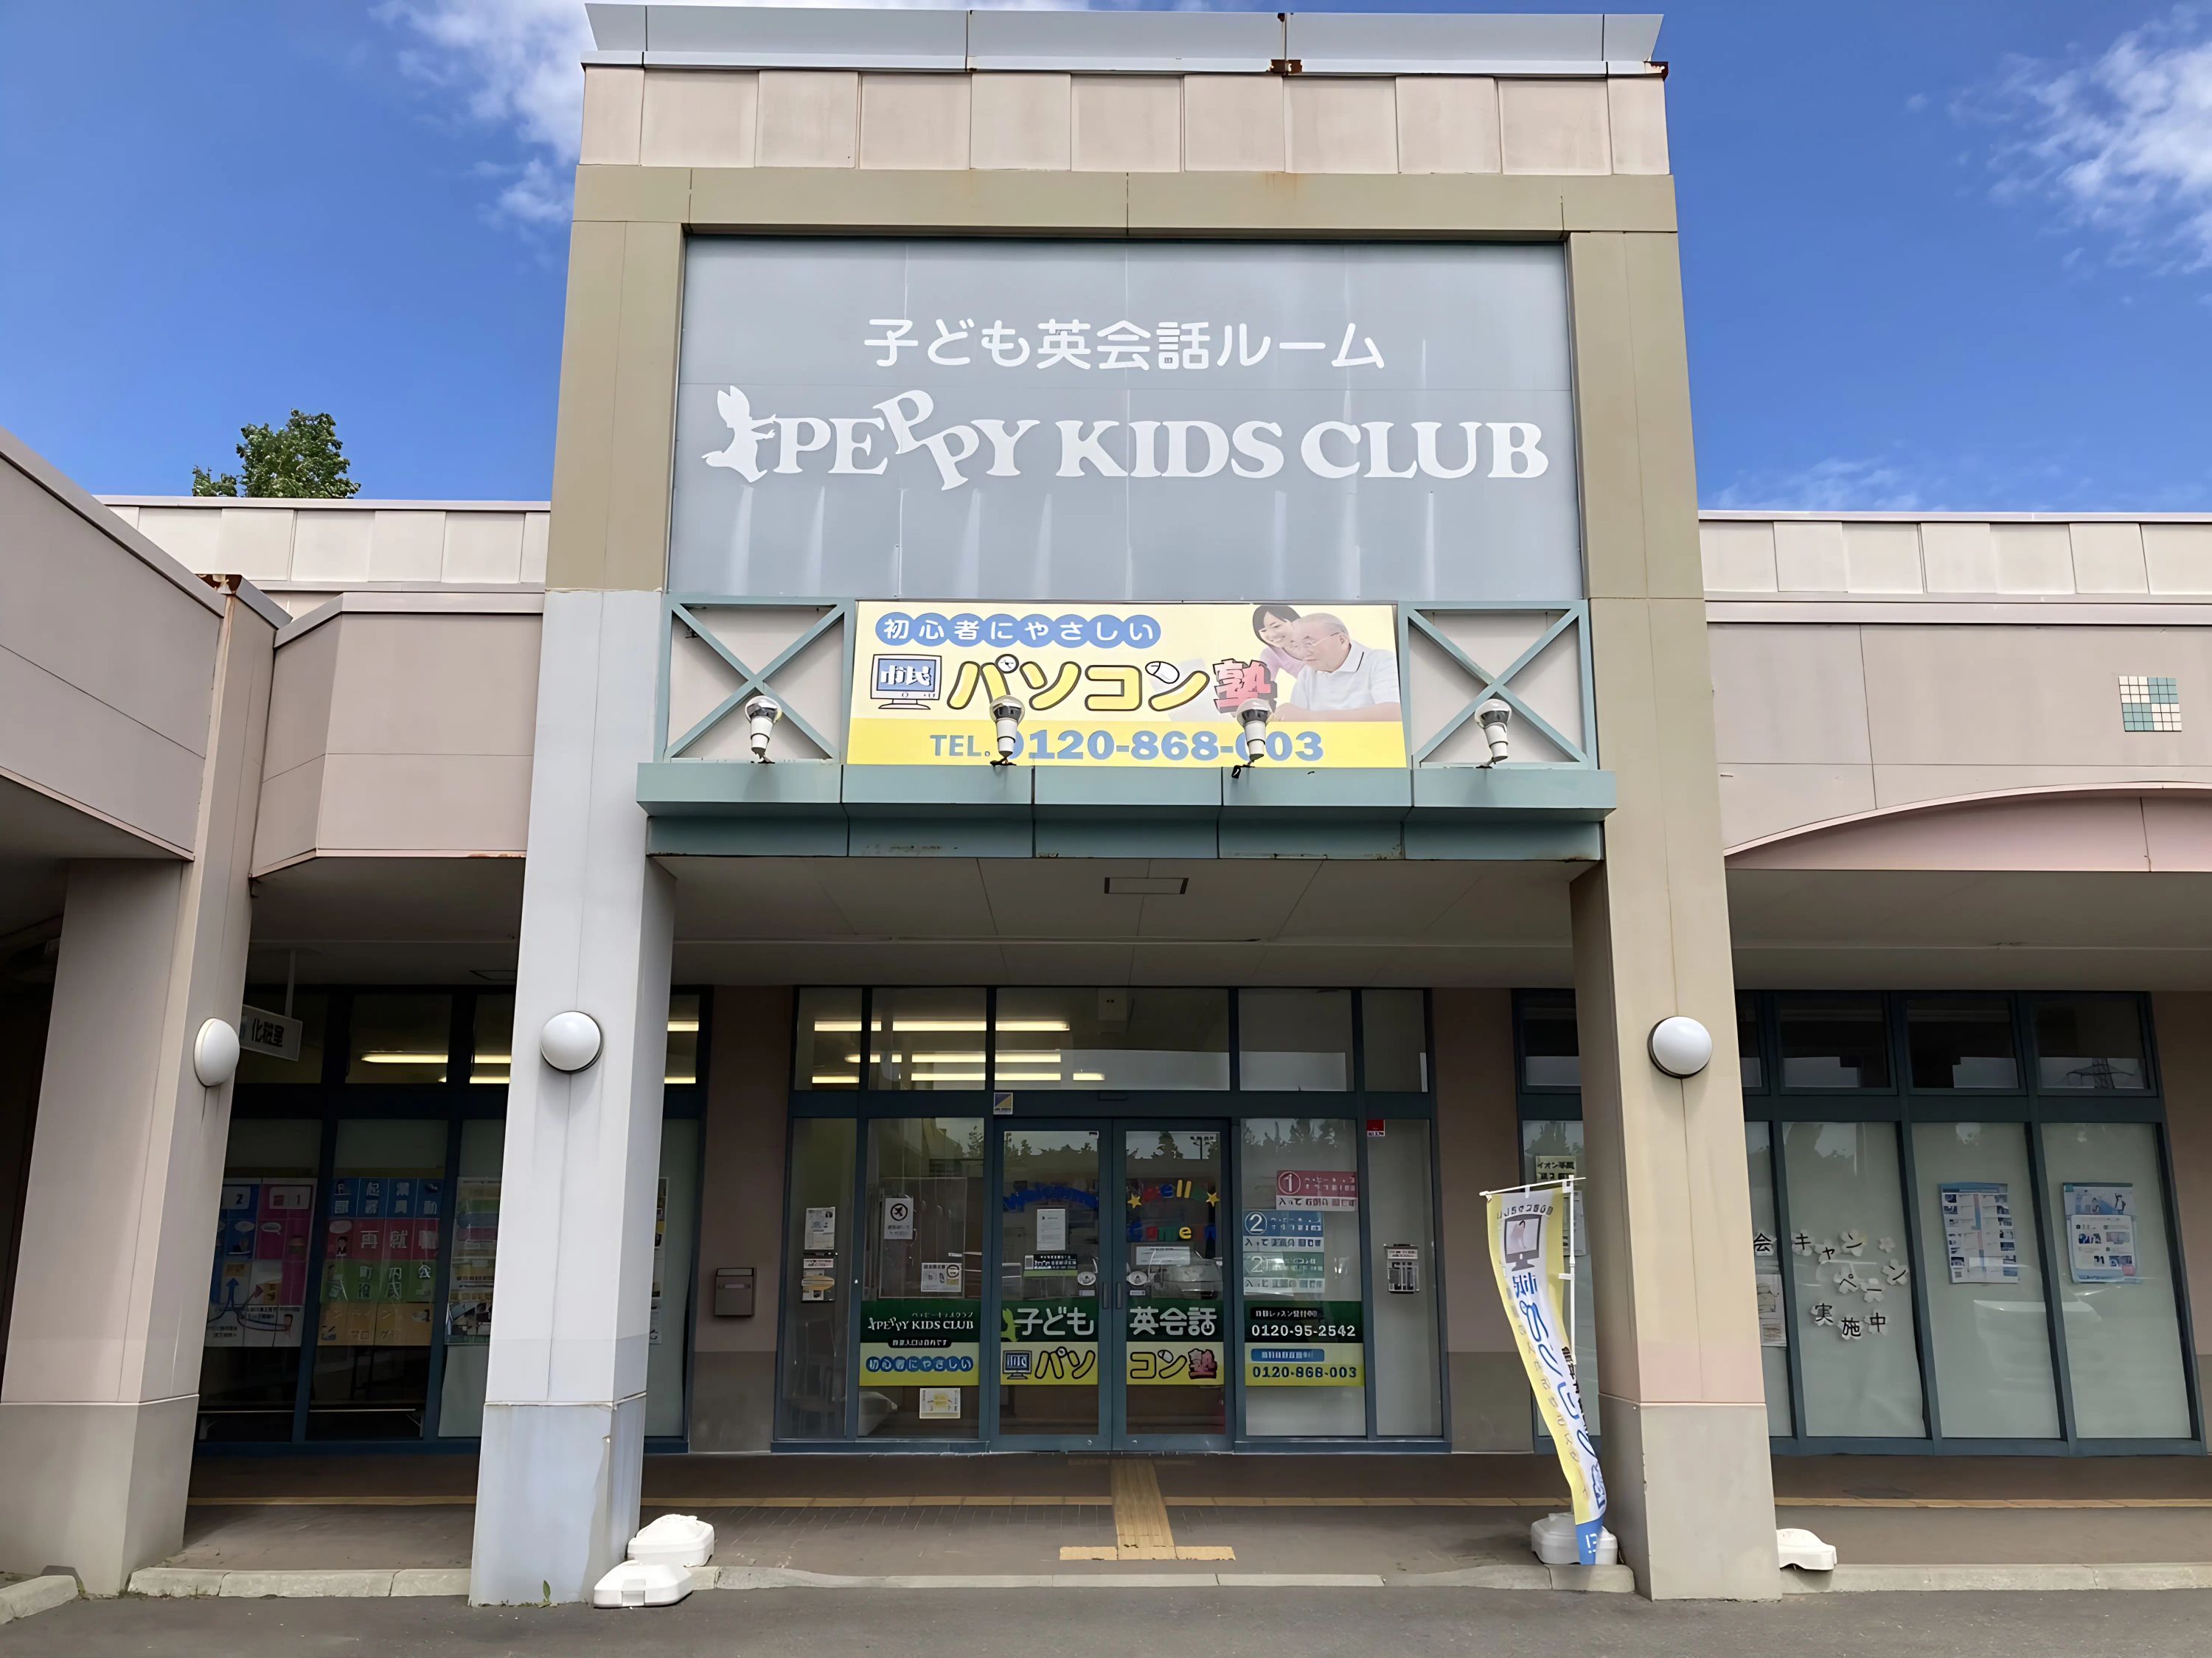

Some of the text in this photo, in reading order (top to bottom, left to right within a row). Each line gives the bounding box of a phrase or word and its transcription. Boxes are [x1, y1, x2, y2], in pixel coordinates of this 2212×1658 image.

[864, 318, 1384, 370] 子ども英会話ルーム
[773, 389, 1549, 491] PEPPY KIDS CLUB
[883, 619, 1155, 642] 初心者にやさしい
[874, 1317, 974, 1331] PEPPY KIDS CLUB
[1014, 1306, 1217, 1336] 子ども 英会話
[1815, 1303, 1886, 1337] 実施中
